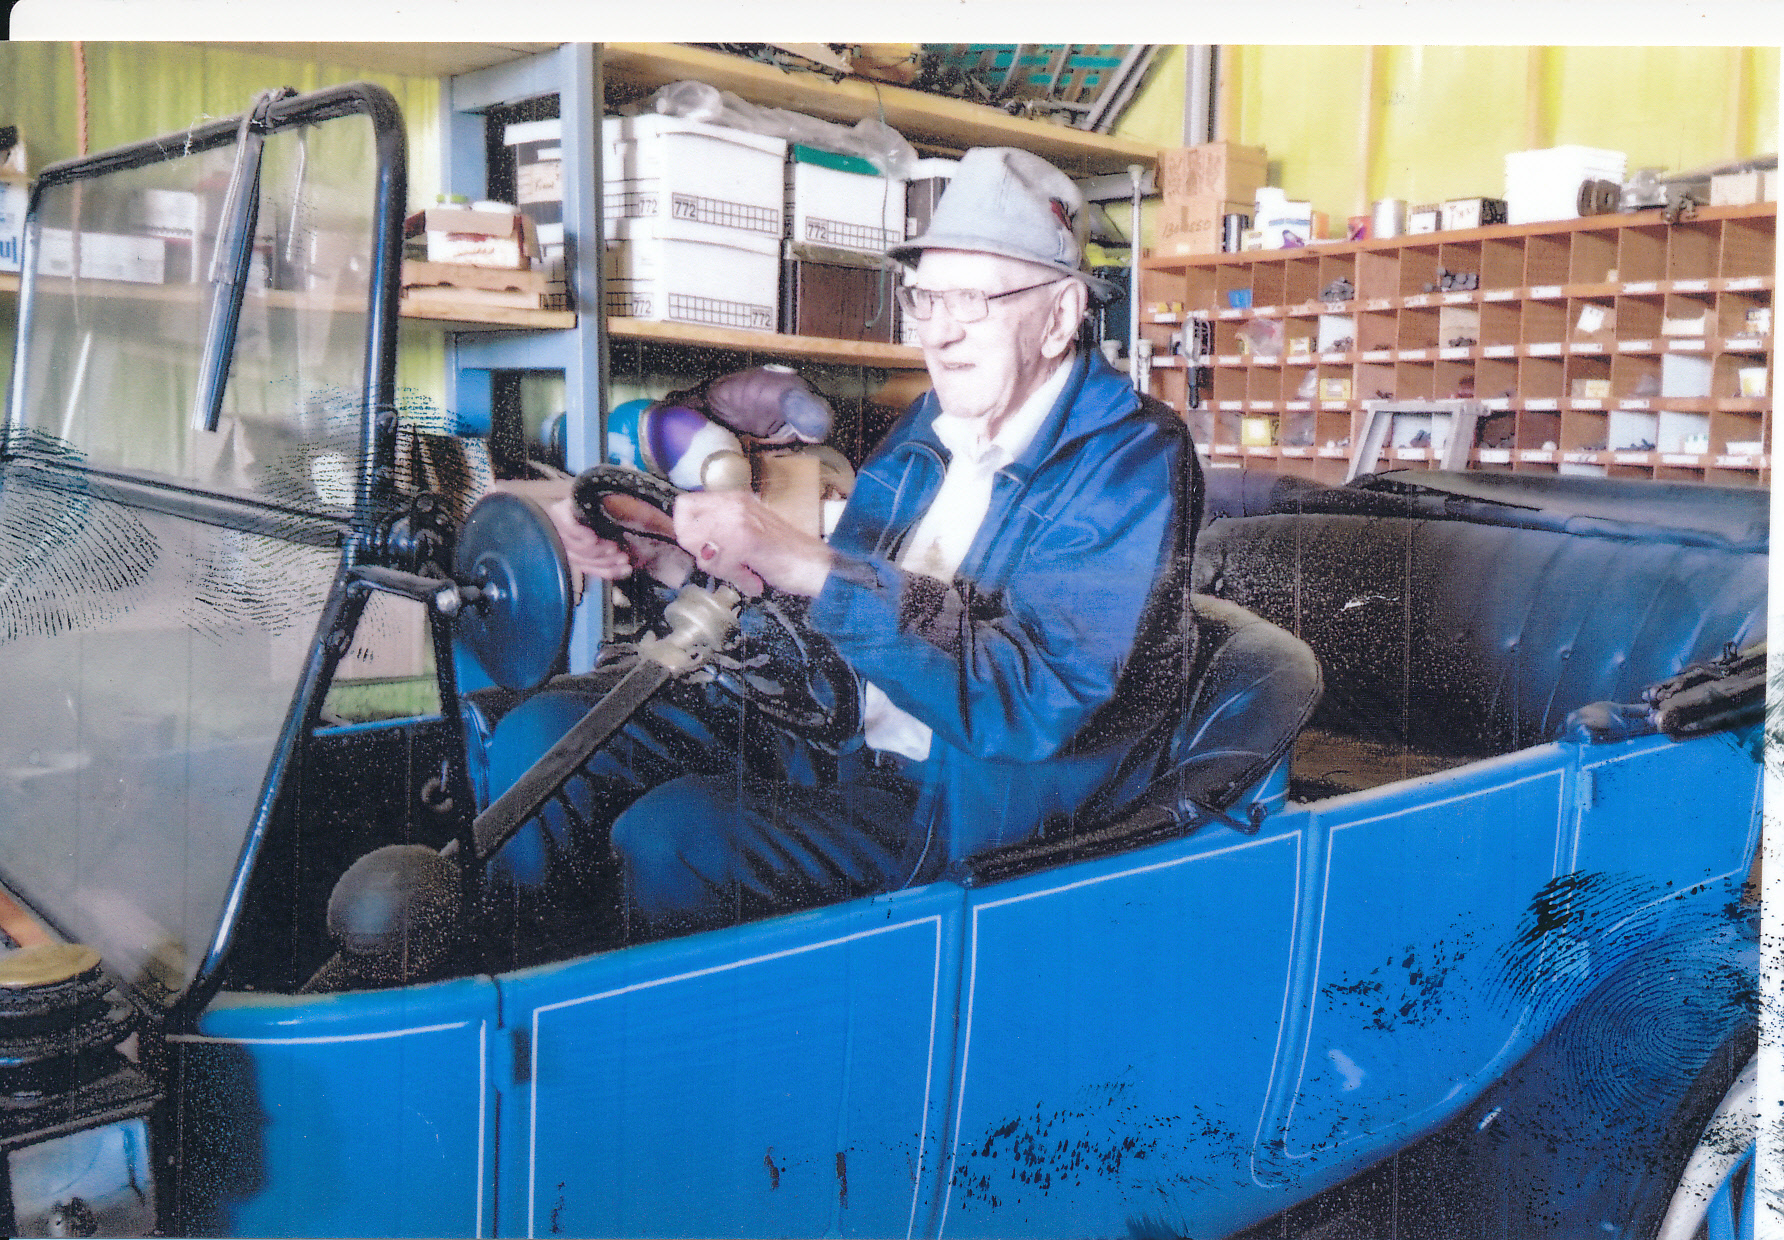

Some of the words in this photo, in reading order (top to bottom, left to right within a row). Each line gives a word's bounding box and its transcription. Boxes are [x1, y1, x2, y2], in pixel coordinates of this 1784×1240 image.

[639, 200, 658, 214] 772
[675, 200, 696, 218] 772
[808, 224, 827, 240] 772
[633, 300, 652, 314] 772
[752, 311, 771, 327] 772
